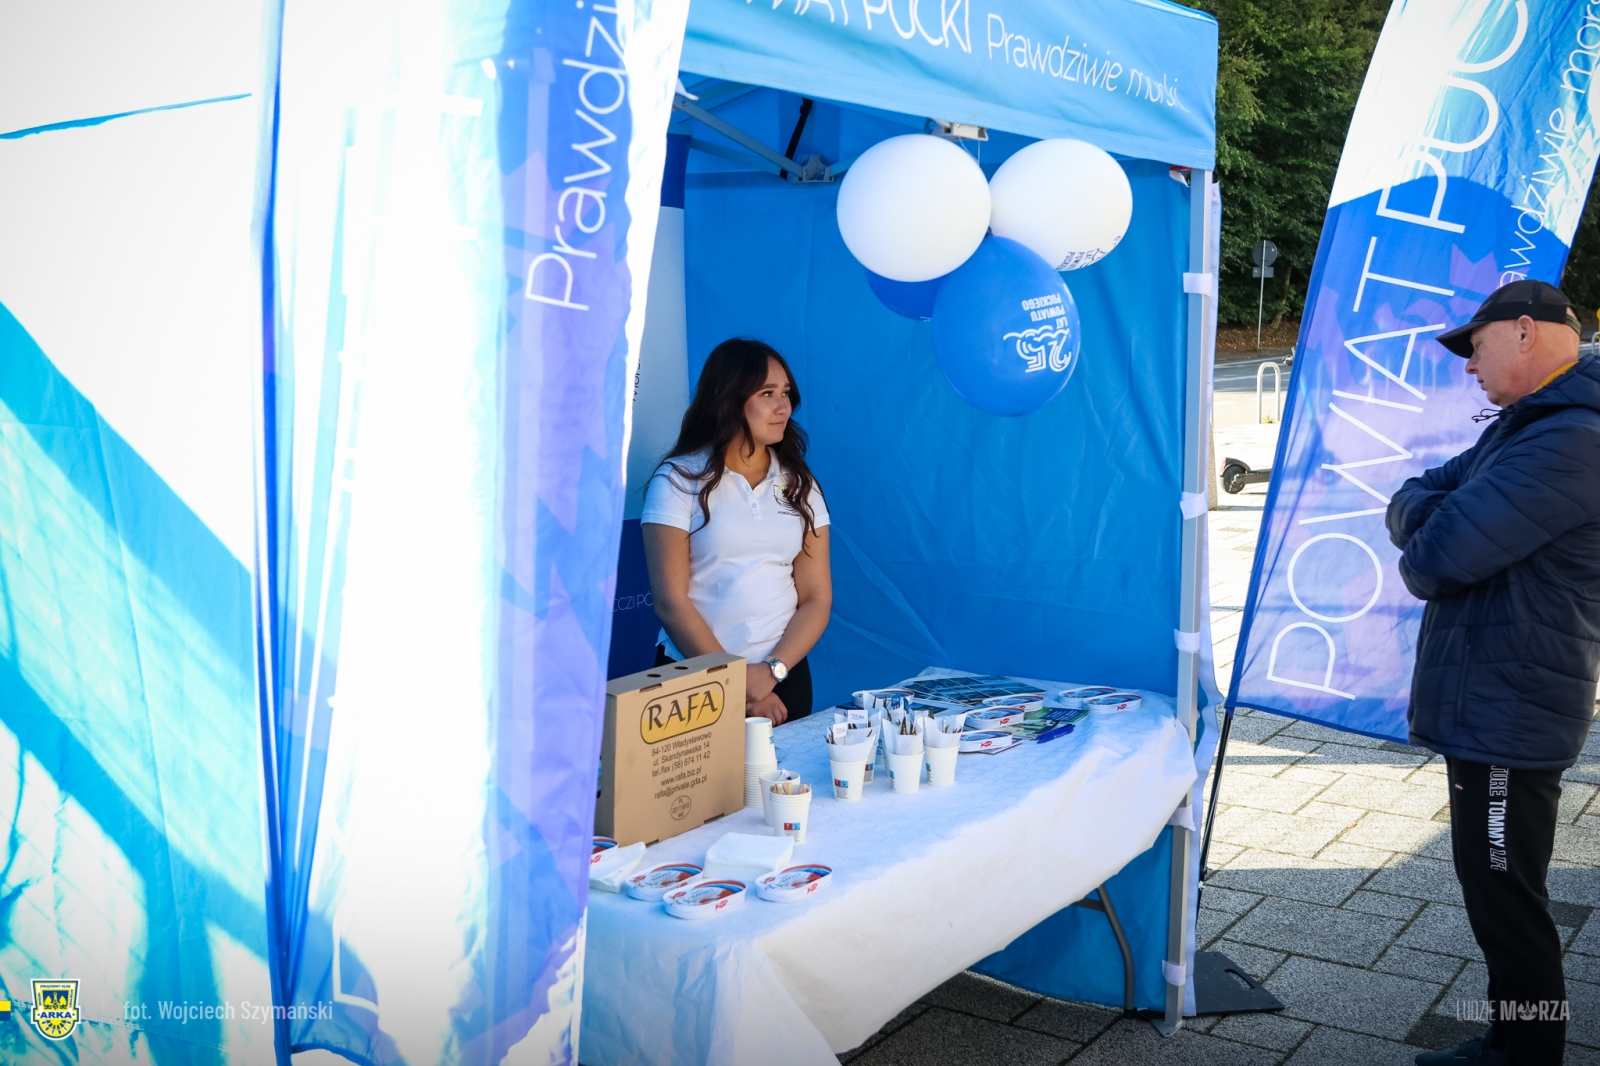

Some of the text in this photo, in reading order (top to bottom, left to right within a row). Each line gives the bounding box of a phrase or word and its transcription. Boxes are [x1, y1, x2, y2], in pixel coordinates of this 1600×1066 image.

[988, 13, 1123, 92] Prawdziwie
[1021, 293, 1063, 312] PUCKIEGO
[1030, 304, 1066, 323] POWIATU
[1015, 329, 1073, 373] 25
[1266, 235, 1456, 701] POWIAT
[647, 690, 718, 732] RAFA
[651, 743, 672, 757] 84-120
[652, 741, 710, 767] ul. Skandynawska 14
[651, 750, 711, 778] tel./fax (58) 674 11 42
[660, 765, 702, 787] www.rafa.biz.pl
[654, 773, 708, 800] rafa@private.gda.pl
[1487, 799, 1507, 848] TOMMY
